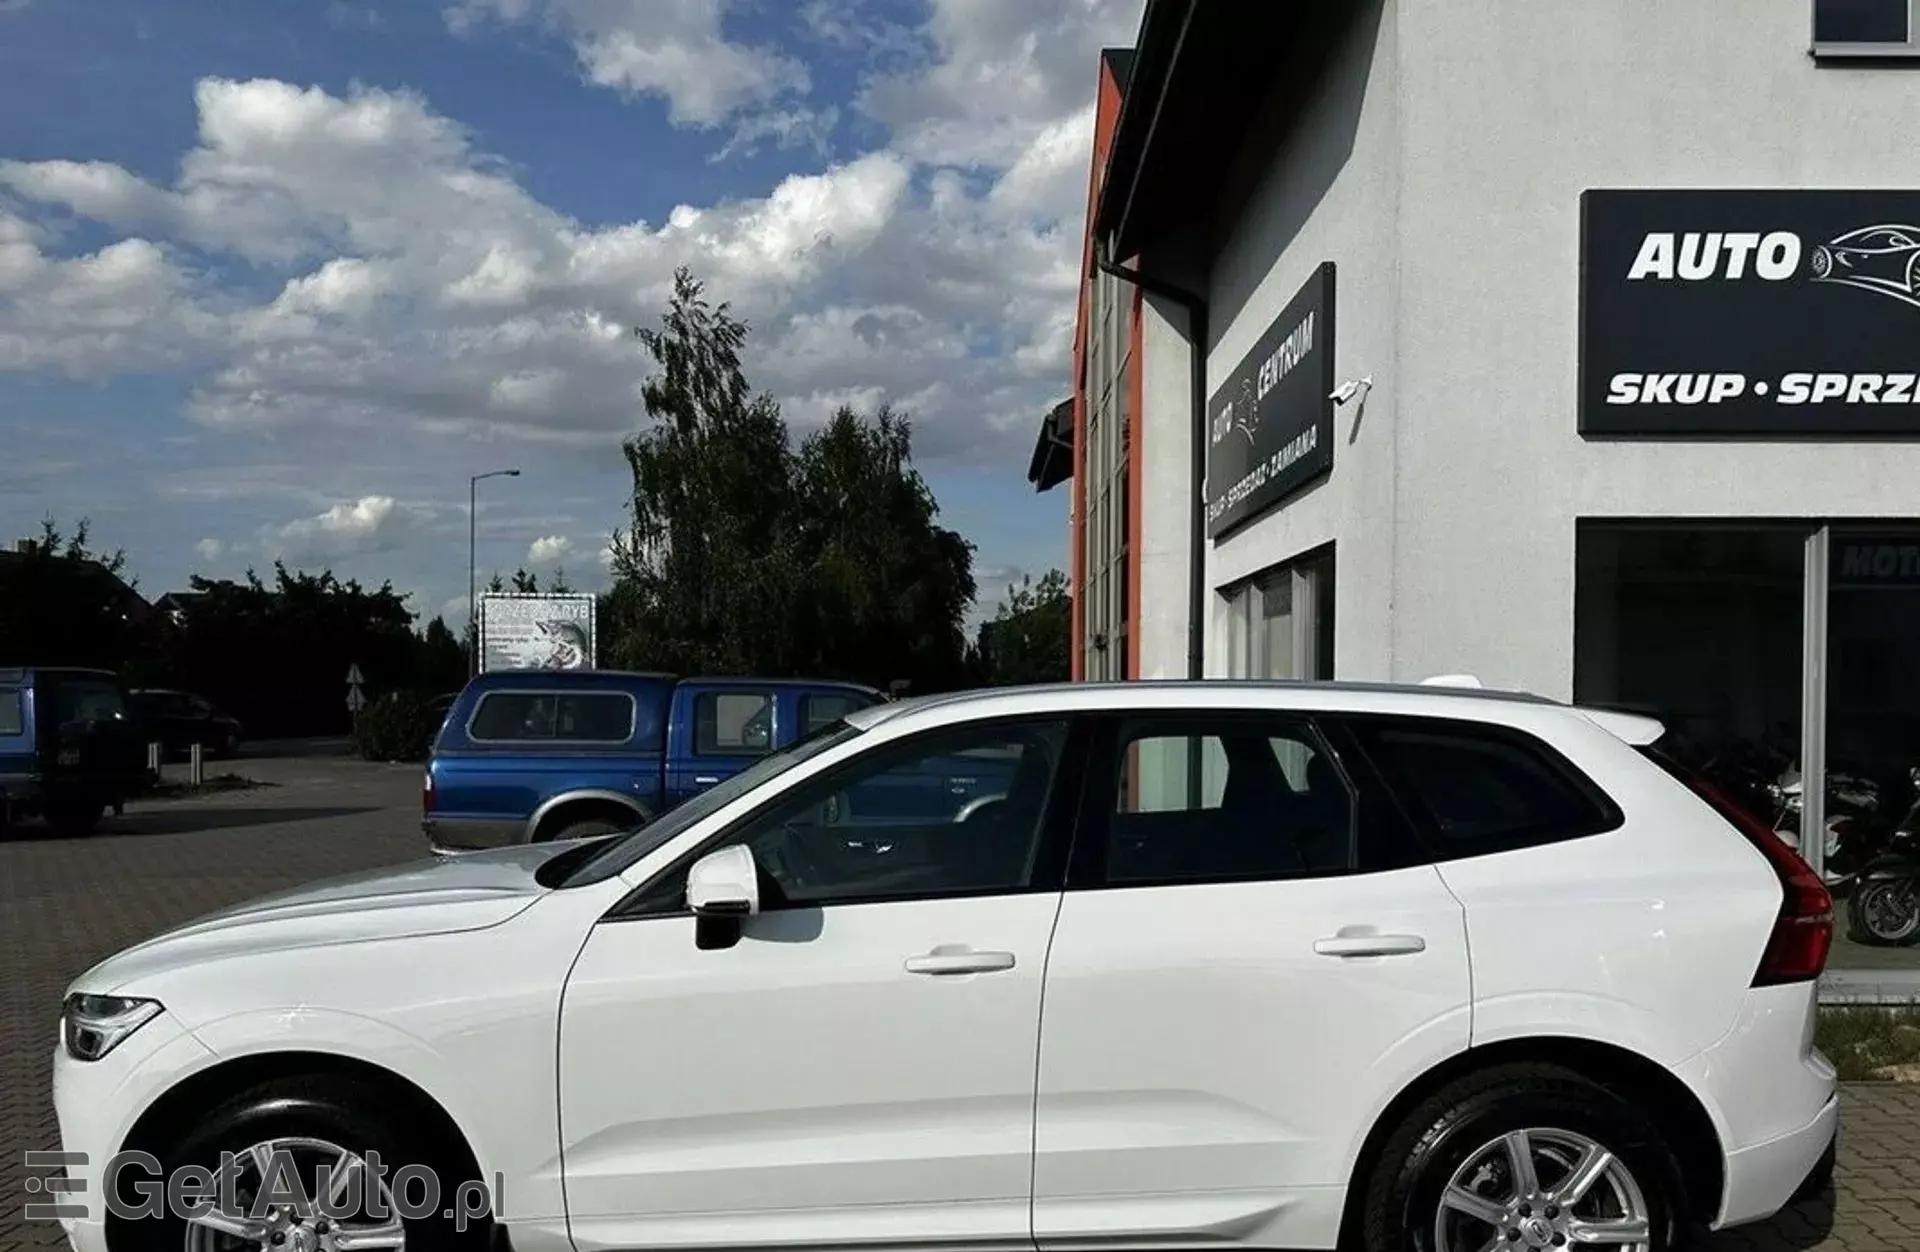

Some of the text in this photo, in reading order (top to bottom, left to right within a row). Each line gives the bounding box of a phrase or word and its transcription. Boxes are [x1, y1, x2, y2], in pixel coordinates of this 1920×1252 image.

[1627, 231, 1801, 280] AUTO
[1258, 311, 1314, 401] CENTRUM
[1606, 373, 1920, 404] SKUP SPRZ
[1841, 545, 1920, 577] MOT
